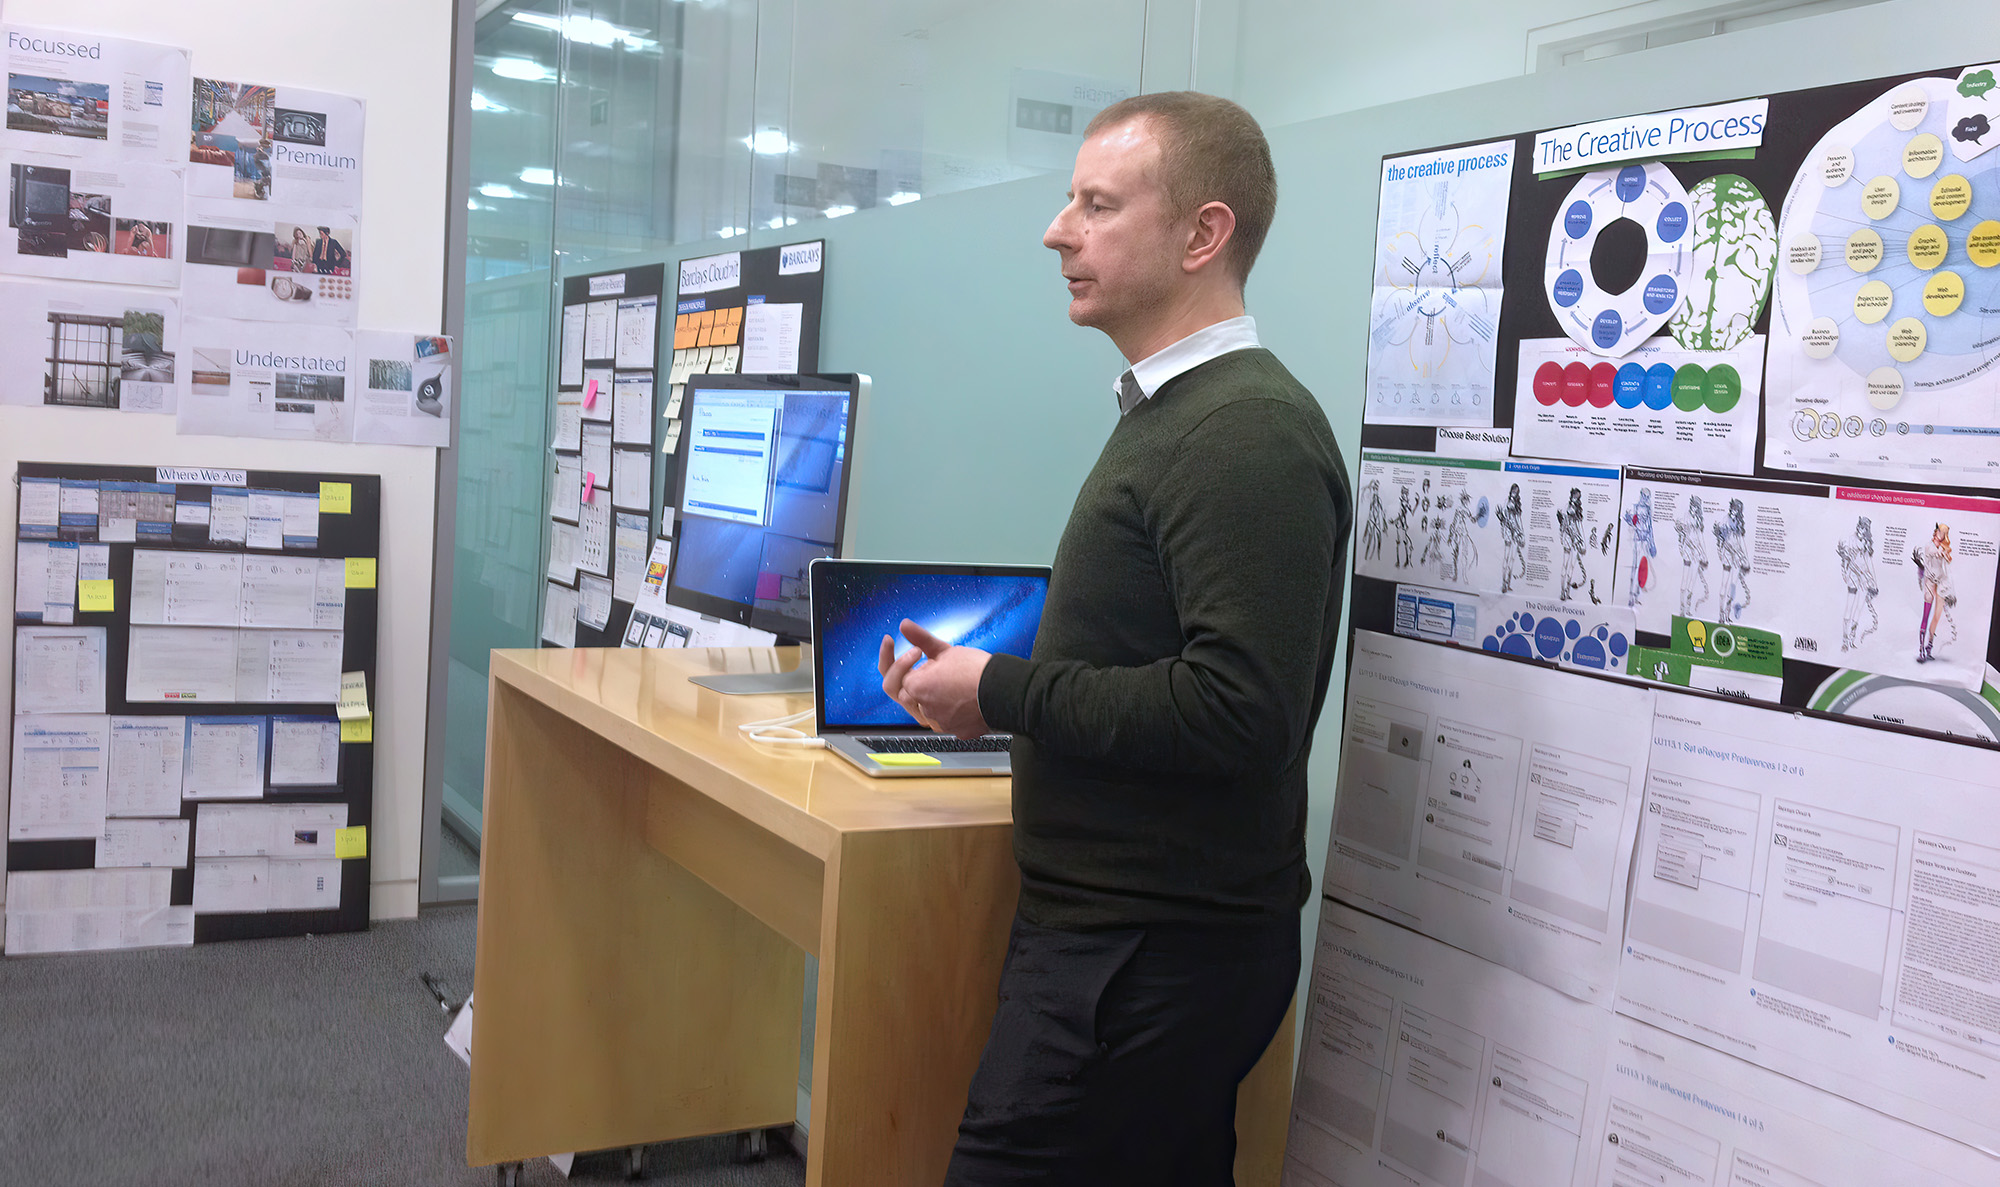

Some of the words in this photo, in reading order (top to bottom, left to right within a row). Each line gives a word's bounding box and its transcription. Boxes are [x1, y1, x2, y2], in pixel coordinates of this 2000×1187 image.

[8, 31, 101, 60] Focussed
[1541, 138, 1572, 165] The
[1577, 125, 1661, 158] Creative
[1668, 113, 1763, 144] Process
[276, 144, 356, 170] Premium
[1387, 164, 1405, 181] the
[1407, 157, 1455, 179] creative
[1457, 152, 1509, 178] process
[788, 247, 820, 266] BARCLAYS
[236, 349, 346, 372] Understated
[1439, 428, 1464, 440] Choose
[1465, 431, 1481, 442] Best
[1481, 432, 1510, 444] Solution
[158, 467, 198, 480] Where
[199, 469, 220, 482] We
[222, 471, 243, 482] Are
[1525, 601, 1536, 609] The
[1537, 602, 1561, 612] Creative
[1562, 605, 1586, 616] Process
